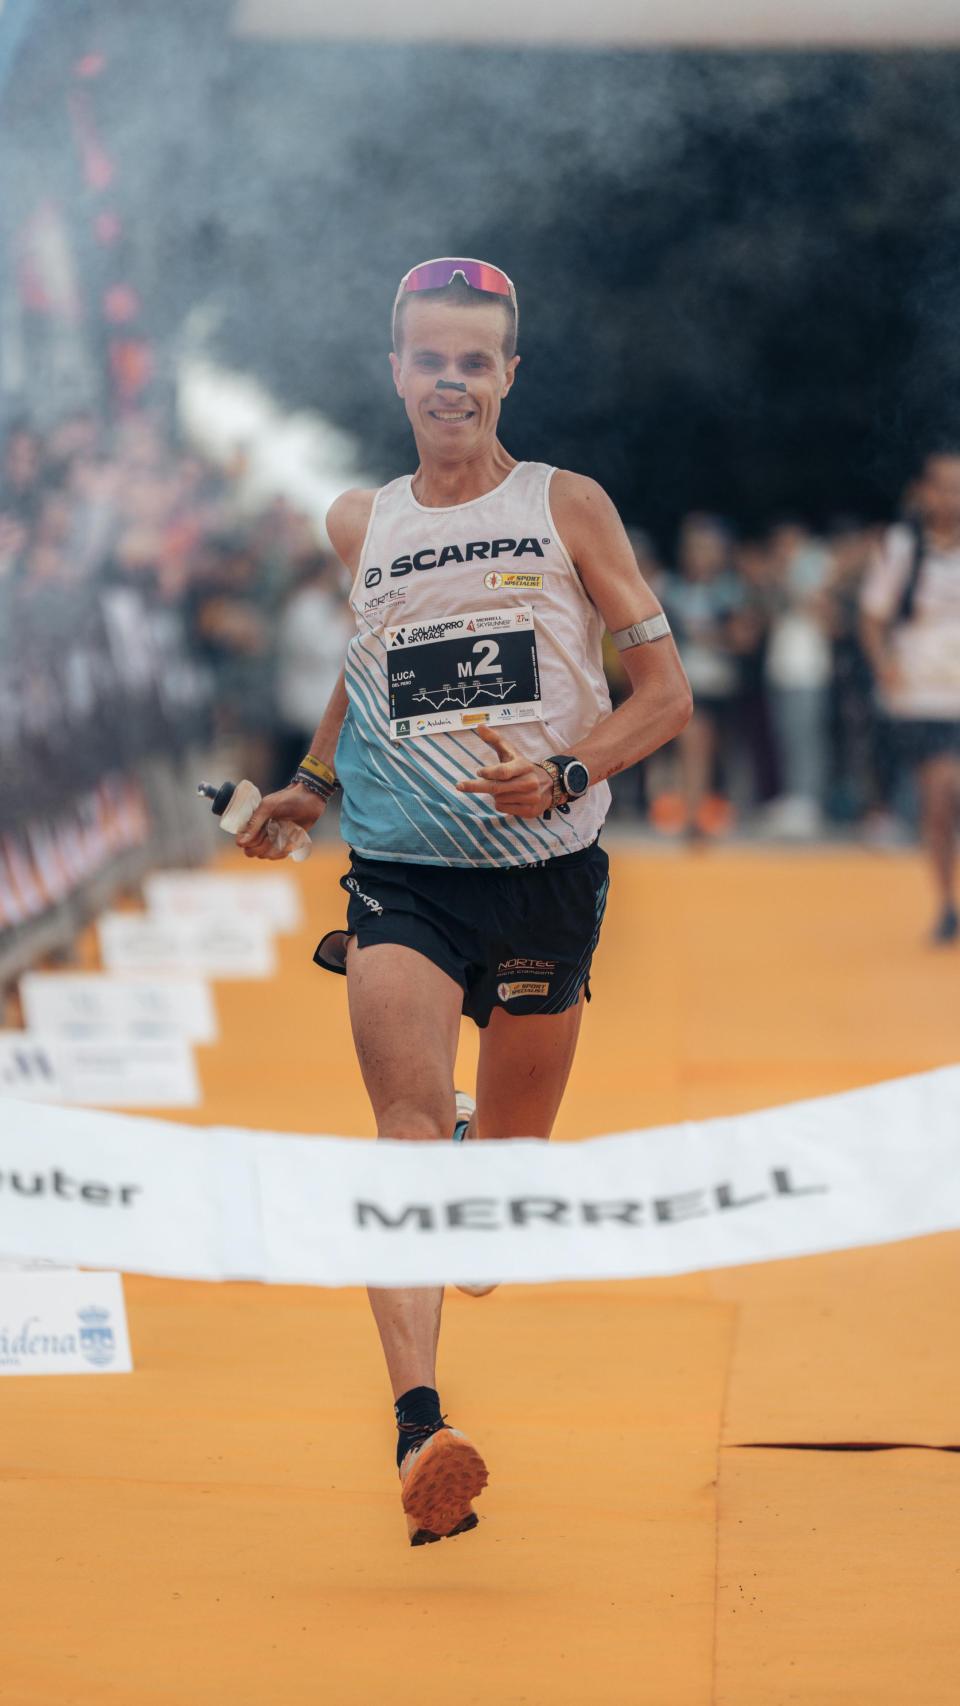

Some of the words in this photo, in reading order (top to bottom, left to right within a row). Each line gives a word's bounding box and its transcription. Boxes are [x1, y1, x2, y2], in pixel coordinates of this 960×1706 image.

[364, 586, 408, 610] NORTEC
[411, 620, 464, 636] CALAMORRO
[408, 630, 445, 643] SKYRACE
[391, 670, 416, 682] LUCA
[498, 958, 558, 971] NORTEC
[0, 1166, 143, 1208] uter
[354, 1164, 829, 1233] MERRELL
